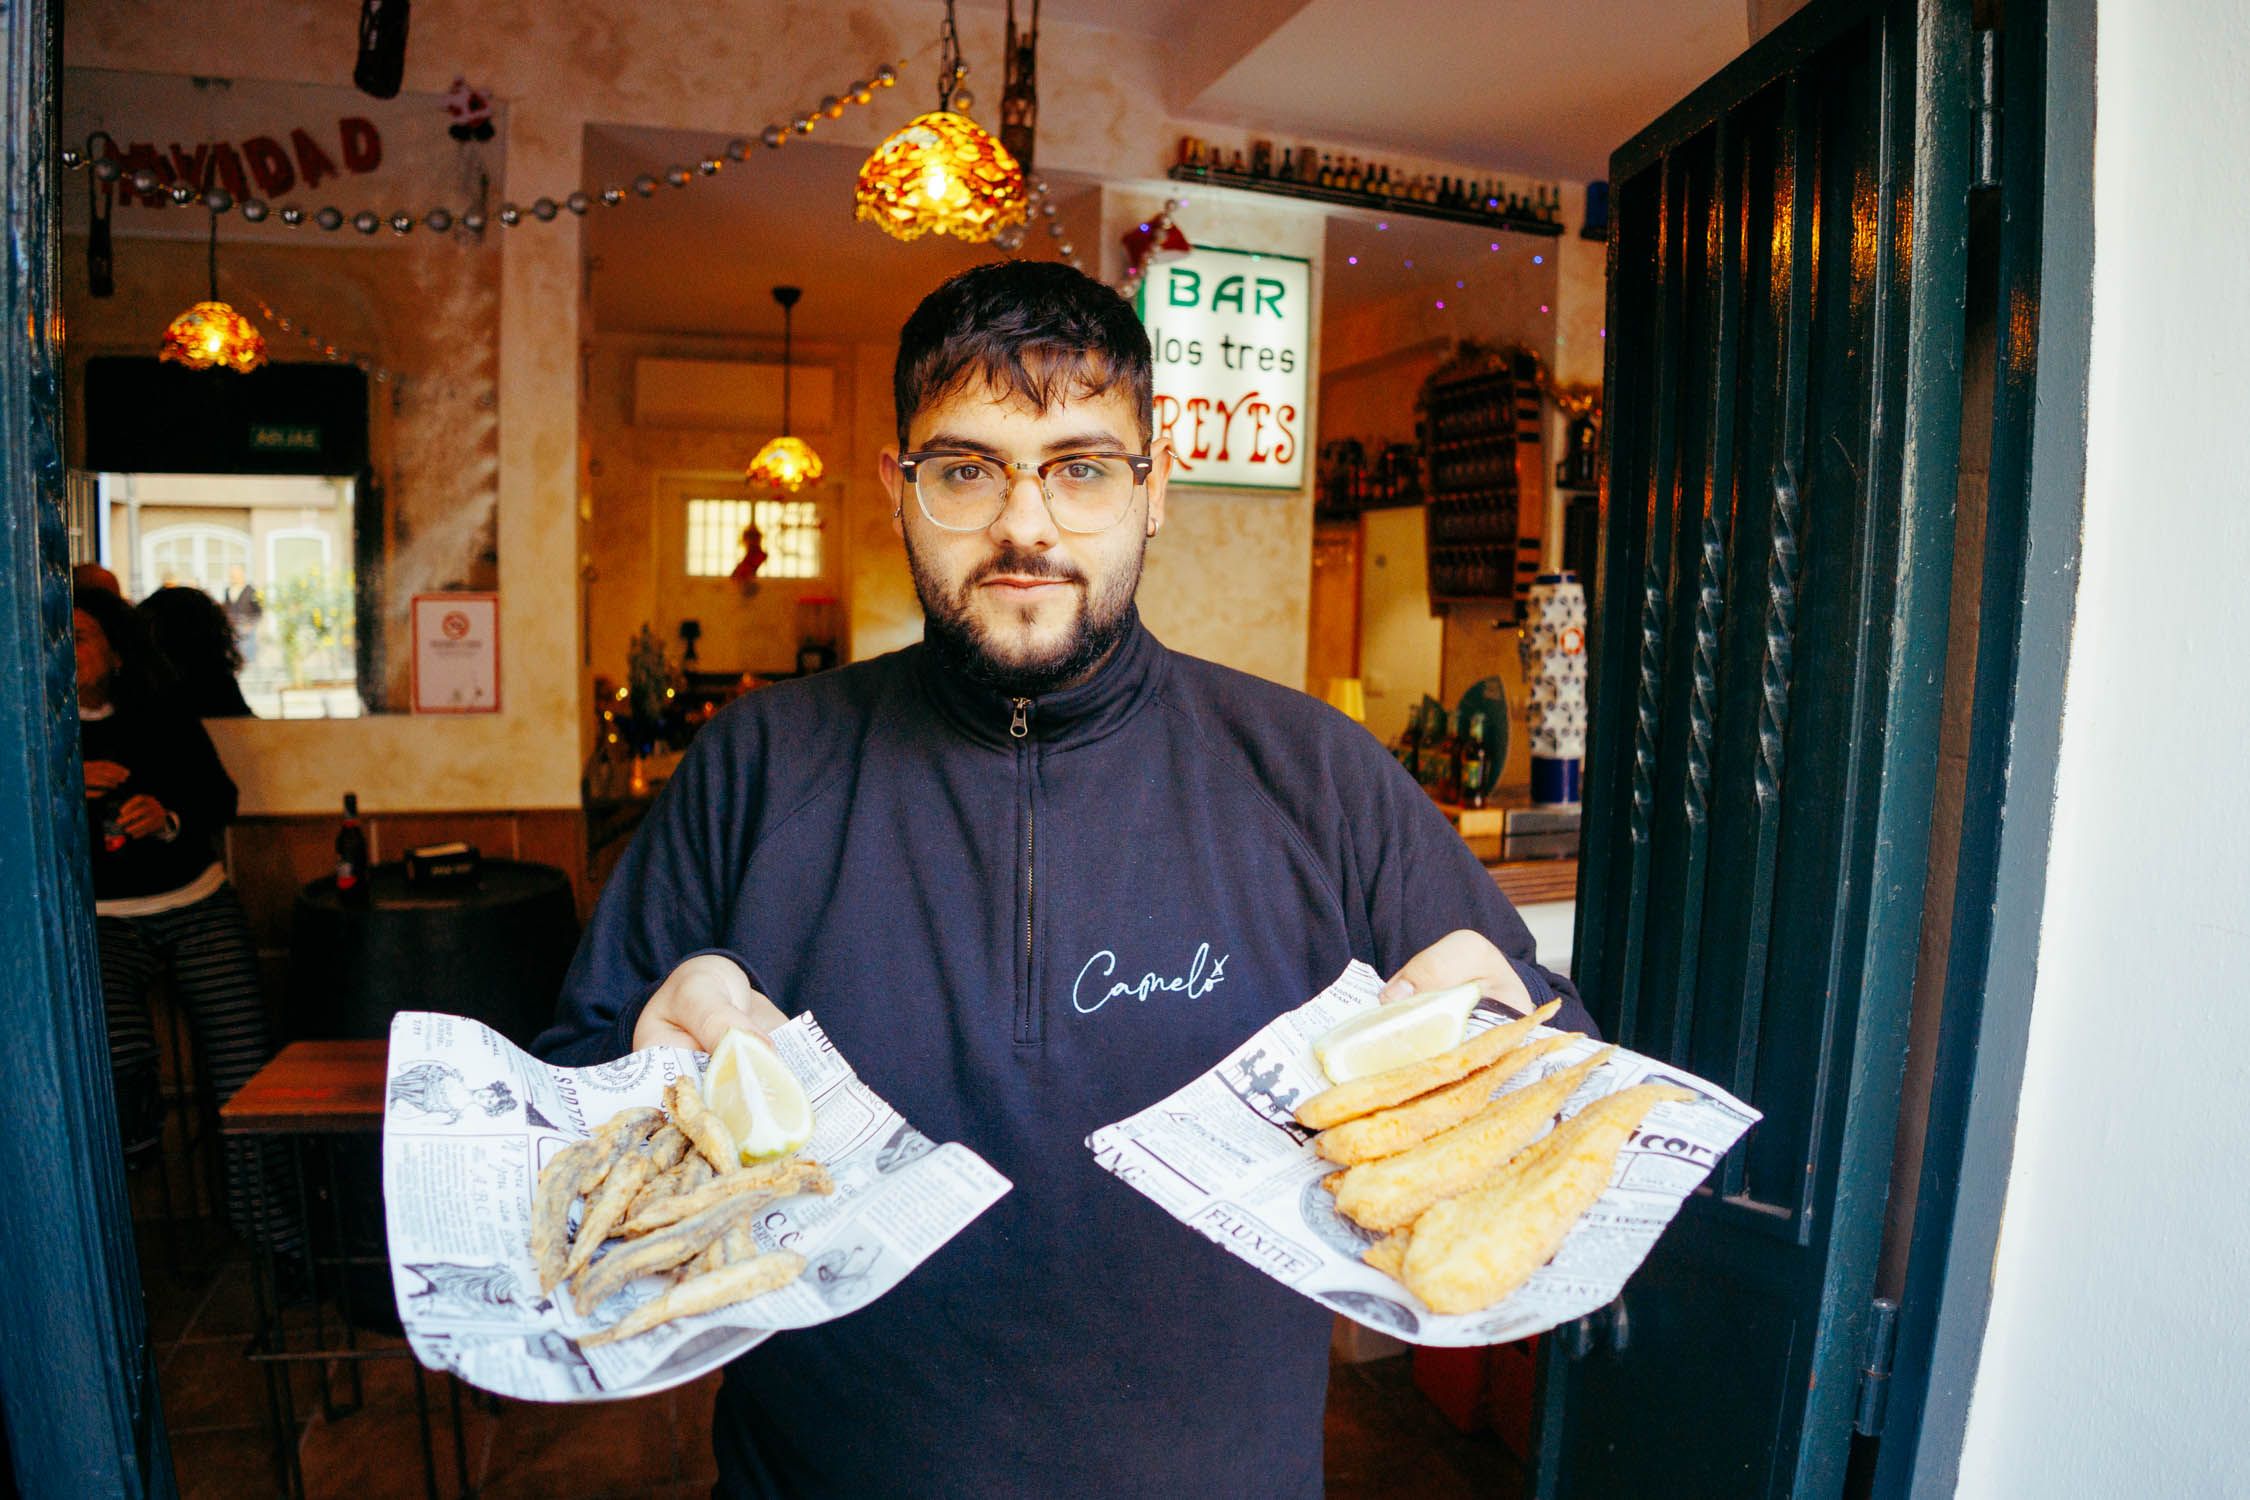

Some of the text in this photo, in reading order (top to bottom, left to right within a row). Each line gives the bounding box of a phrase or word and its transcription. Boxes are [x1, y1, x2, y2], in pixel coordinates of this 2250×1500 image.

[1169, 267, 1286, 319] BAR
[1155, 328, 1295, 374] los tres
[1152, 391, 1296, 471] REYES
[1073, 942, 1229, 1014] Camelo
[1206, 1208, 1306, 1273] FLUXITE
